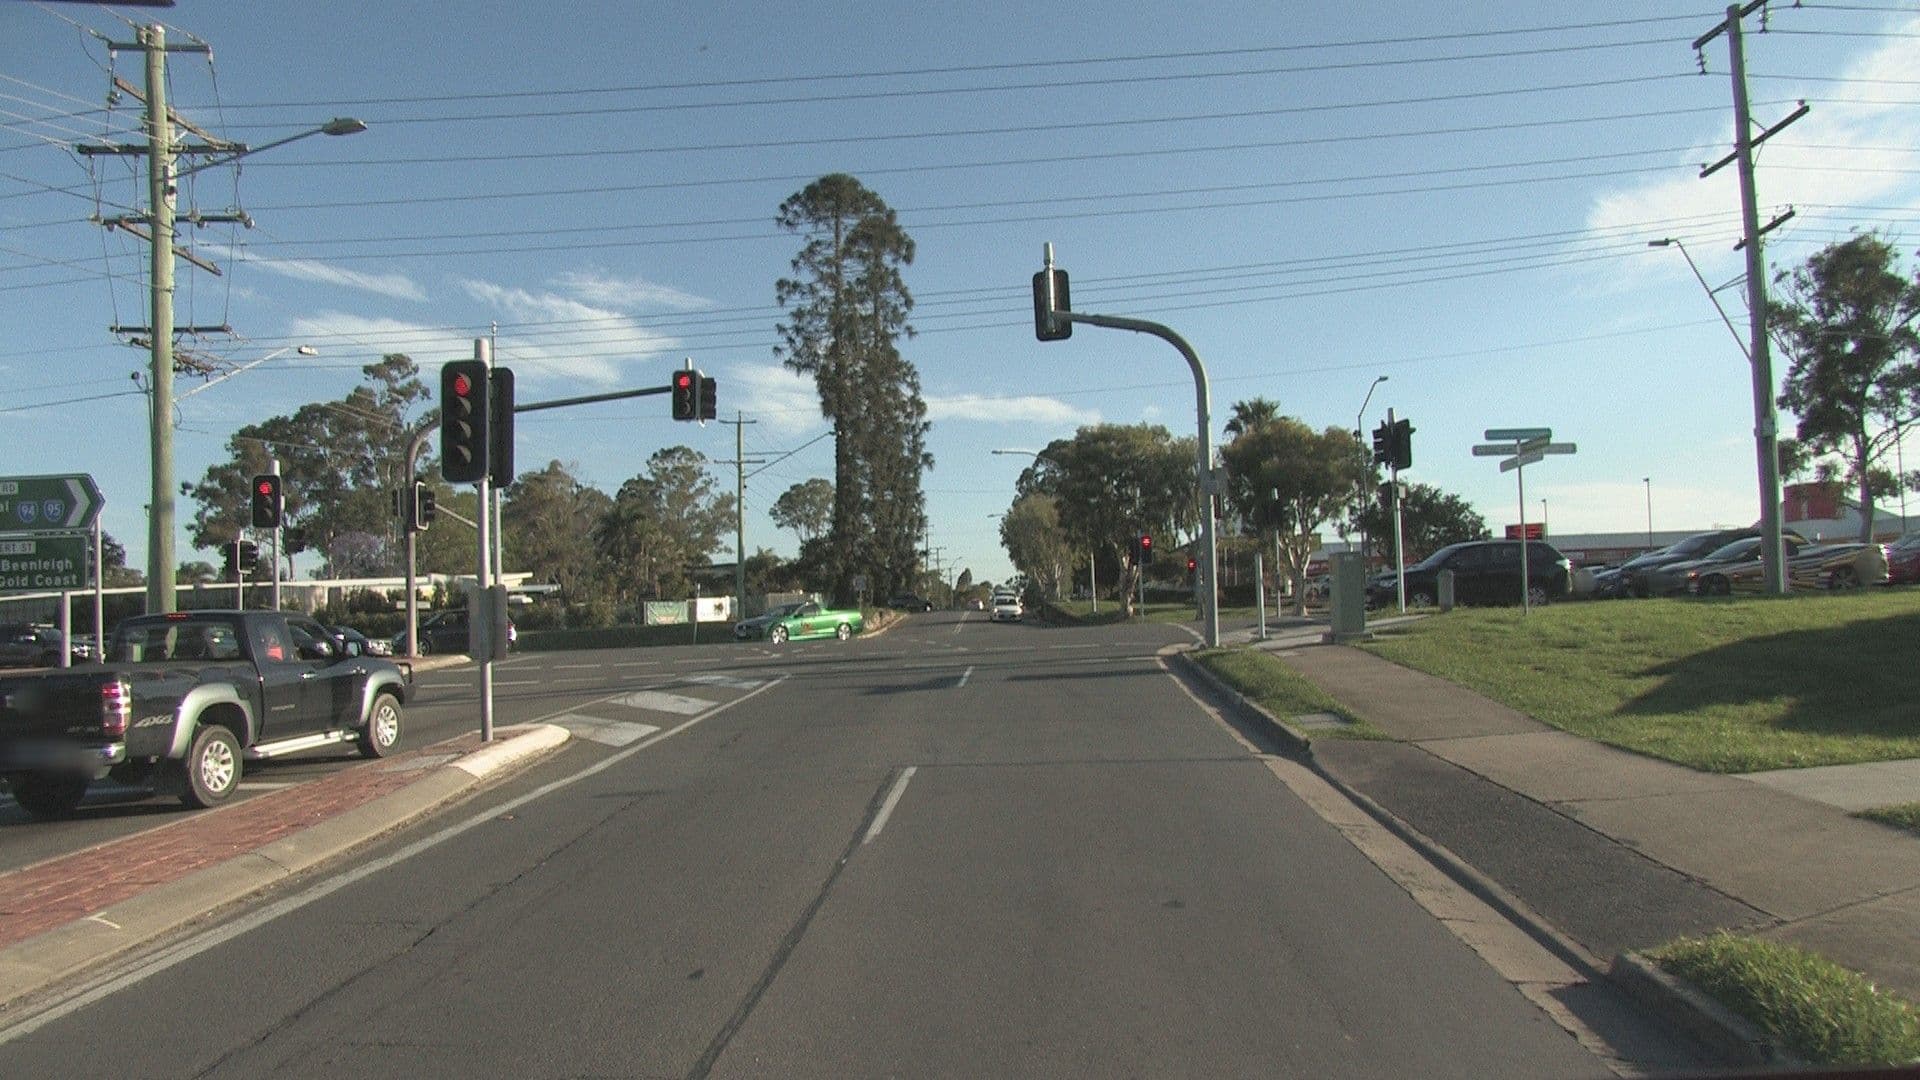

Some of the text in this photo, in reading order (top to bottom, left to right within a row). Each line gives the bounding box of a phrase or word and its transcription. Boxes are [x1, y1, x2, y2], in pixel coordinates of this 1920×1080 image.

[3, 483, 16, 493] RD
[47, 503, 61, 516] 95
[1, 558, 73, 572] Beenleigh
[35, 573, 77, 587] Coast
